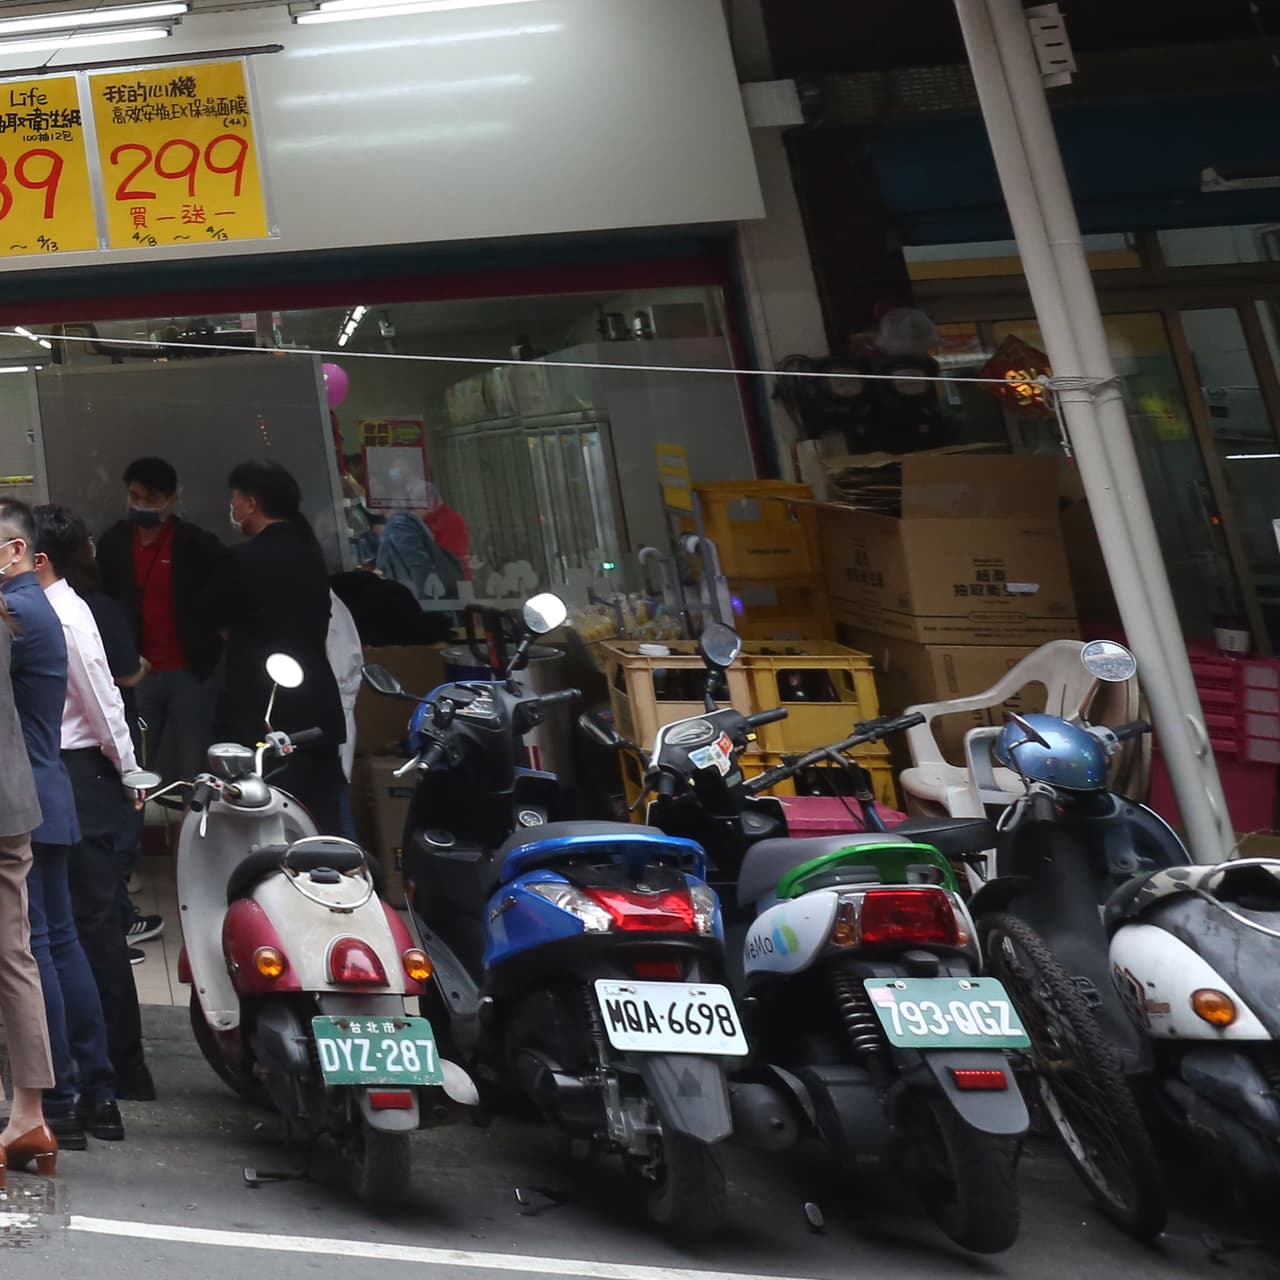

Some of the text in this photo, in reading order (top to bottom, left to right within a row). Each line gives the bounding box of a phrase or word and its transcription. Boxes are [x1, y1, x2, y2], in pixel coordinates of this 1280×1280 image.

[10, 87, 49, 107] Life
[102, 75, 197, 104] 我的心機
[110, 133, 249, 201] 299
[130, 205, 236, 230] 買一送一
[605, 998, 738, 1038] MQA-6698
[876, 1000, 1024, 1037] 793-QGZ
[318, 1038, 436, 1073] DYZ-287
